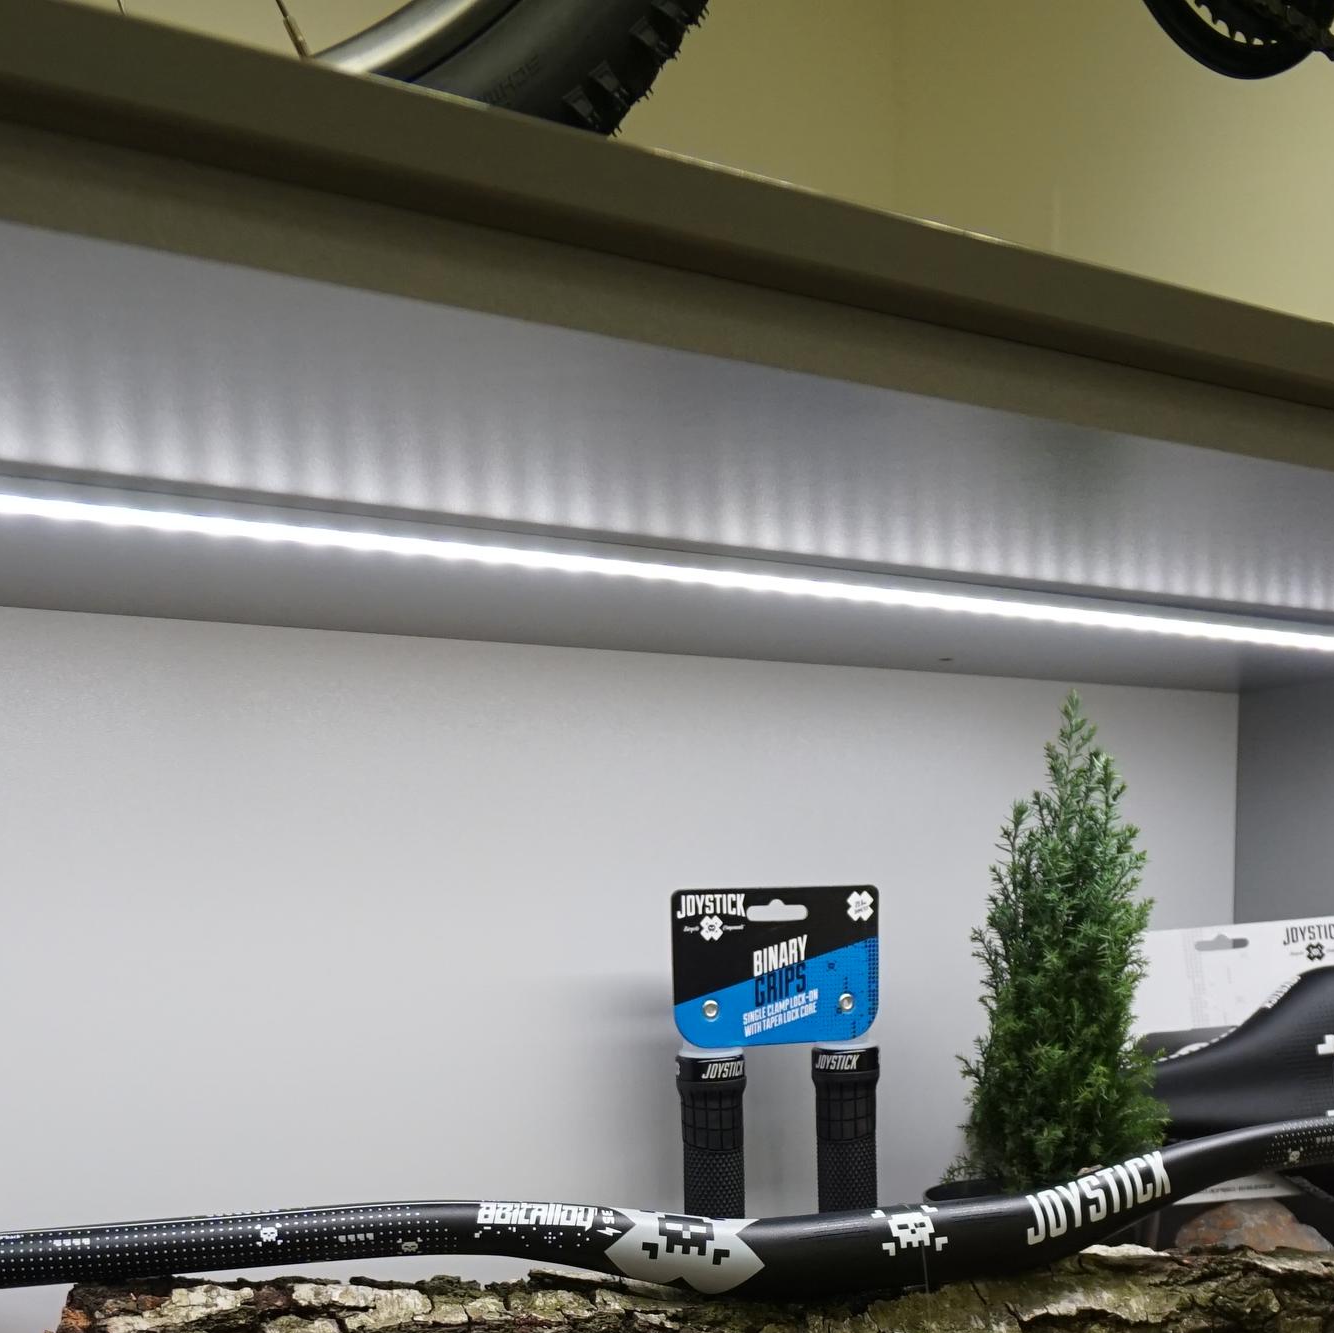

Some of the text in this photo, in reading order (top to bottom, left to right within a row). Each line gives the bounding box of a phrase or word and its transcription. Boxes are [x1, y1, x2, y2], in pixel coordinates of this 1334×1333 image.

[676, 893, 746, 919] JOYSTICK
[753, 934, 808, 977] BINARY
[755, 962, 806, 1007] GRIPS
[742, 988, 819, 1025] SINGLE CLAMP LOCK-ON
[744, 1002, 817, 1038] WITH TAPER LOCK CORE
[816, 1054, 859, 1070] JOYSTICK
[1026, 1150, 1171, 1246] JOYSTICK
